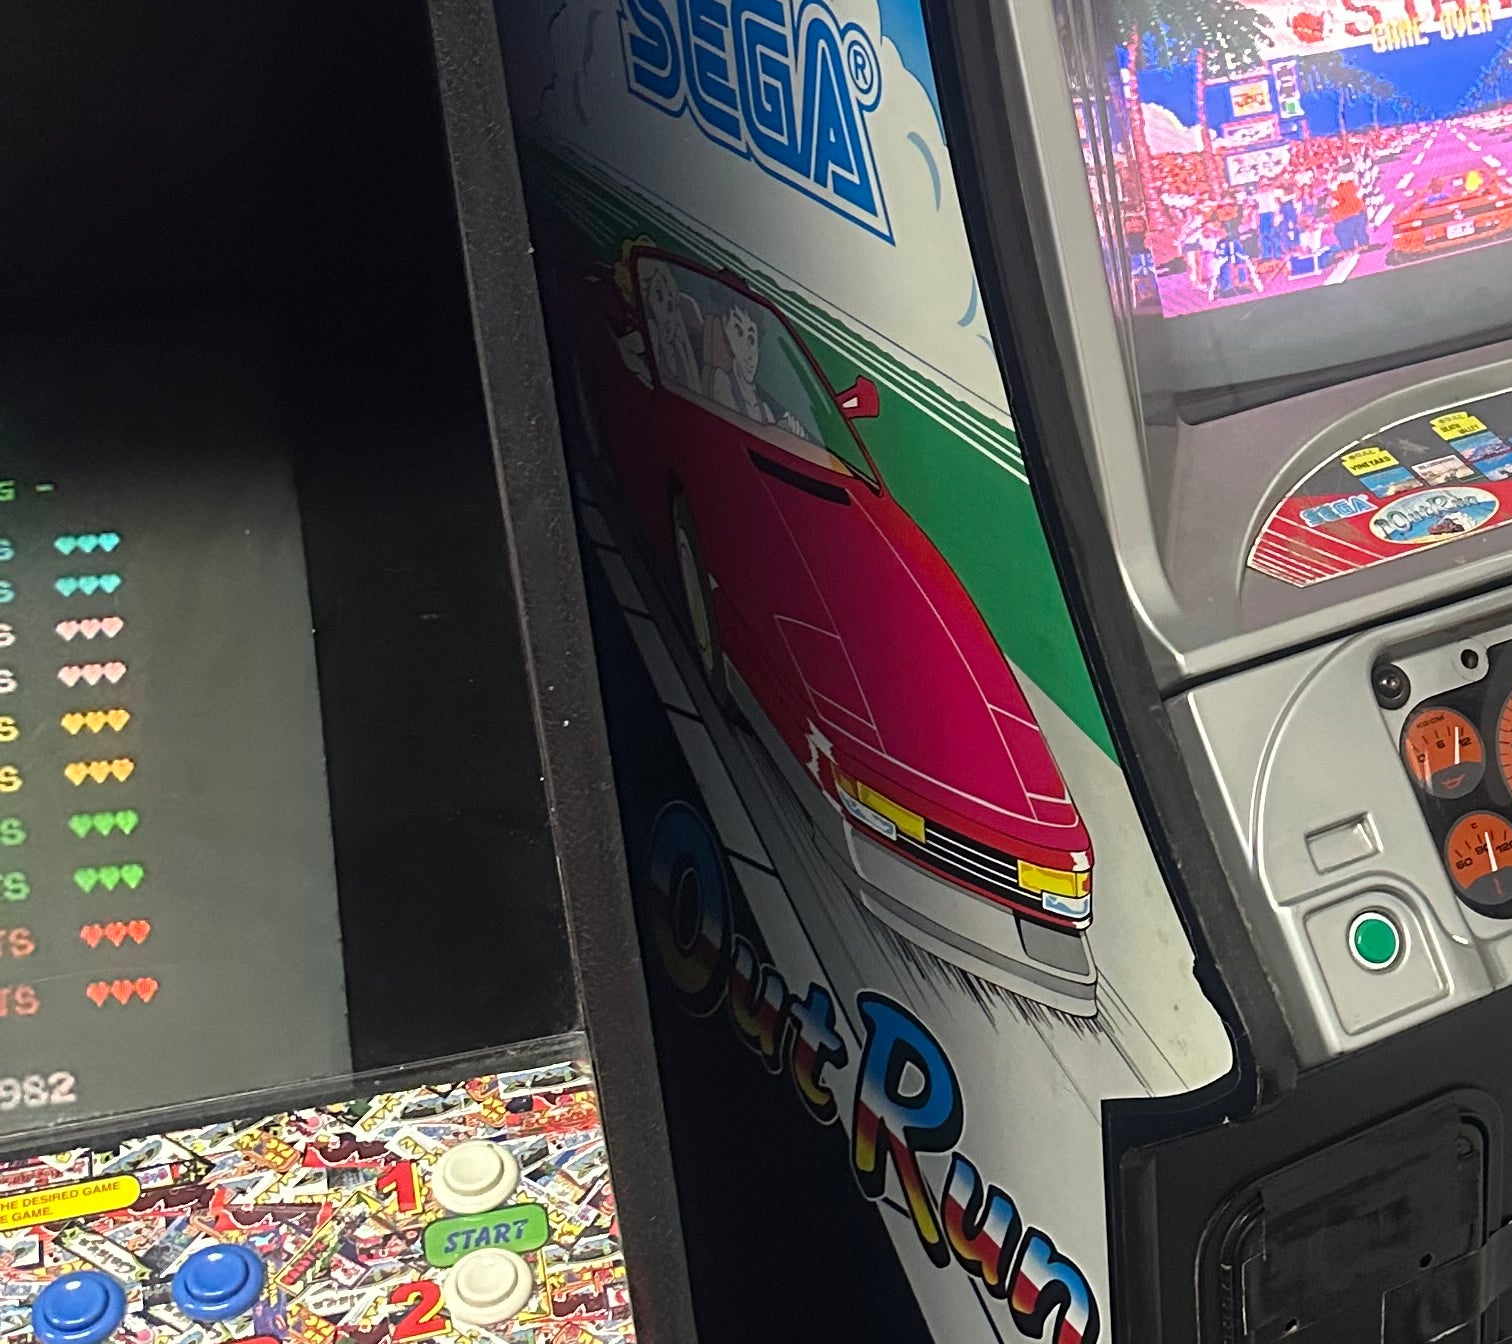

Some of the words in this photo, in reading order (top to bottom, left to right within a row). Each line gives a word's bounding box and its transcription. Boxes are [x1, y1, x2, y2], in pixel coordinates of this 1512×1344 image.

[1439, 3, 1493, 40] OVER
[0, 1200, 19, 1212] HE
[22, 1189, 79, 1207] DESIRED
[82, 1181, 121, 1197] GAME
[375, 1160, 423, 1215] 1
[444, 1219, 529, 1253] START
[388, 1281, 451, 1343] 2
